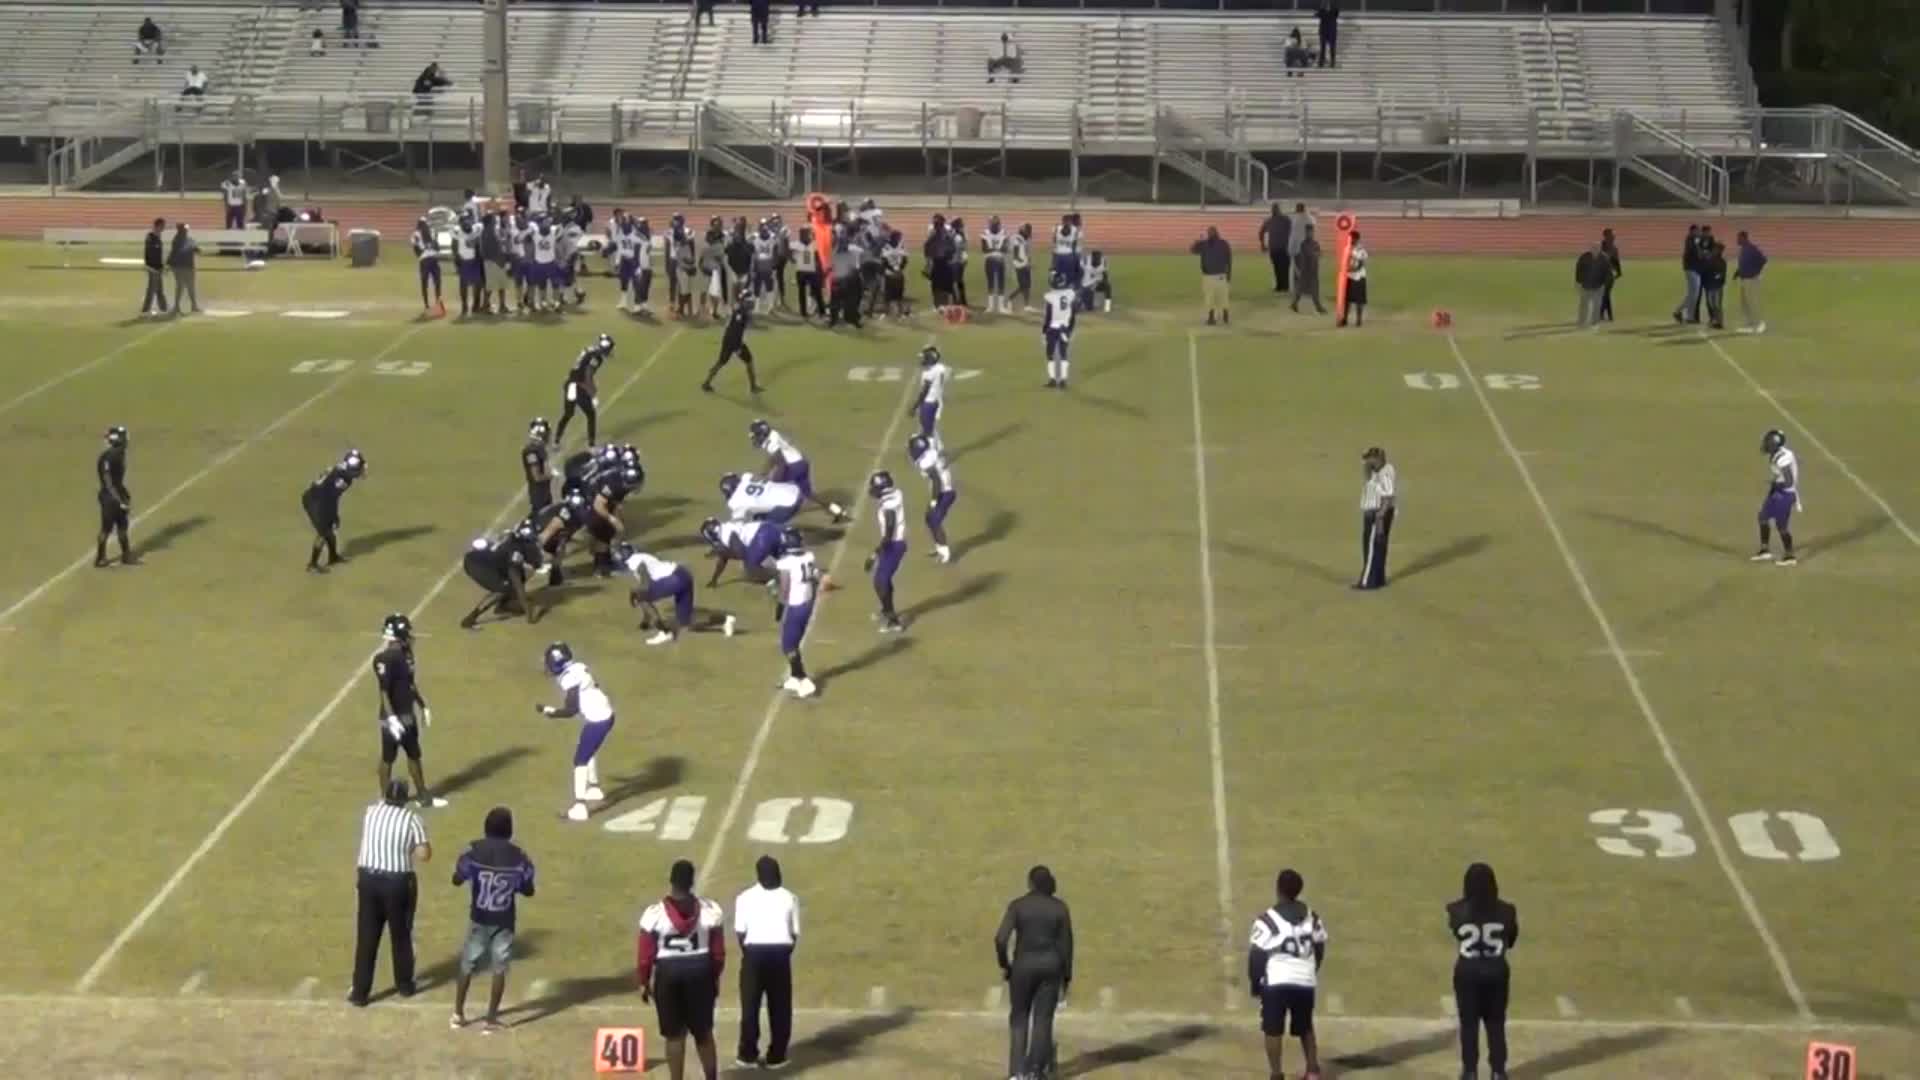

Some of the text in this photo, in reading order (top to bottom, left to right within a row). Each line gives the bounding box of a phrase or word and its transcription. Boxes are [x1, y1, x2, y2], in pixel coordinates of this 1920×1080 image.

[604, 796, 854, 843] 40
[1588, 808, 1841, 861] 30
[477, 870, 513, 911] 12
[1457, 922, 1504, 959] 25
[601, 1033, 638, 1068] 40
[1812, 1048, 1851, 1080] 30
